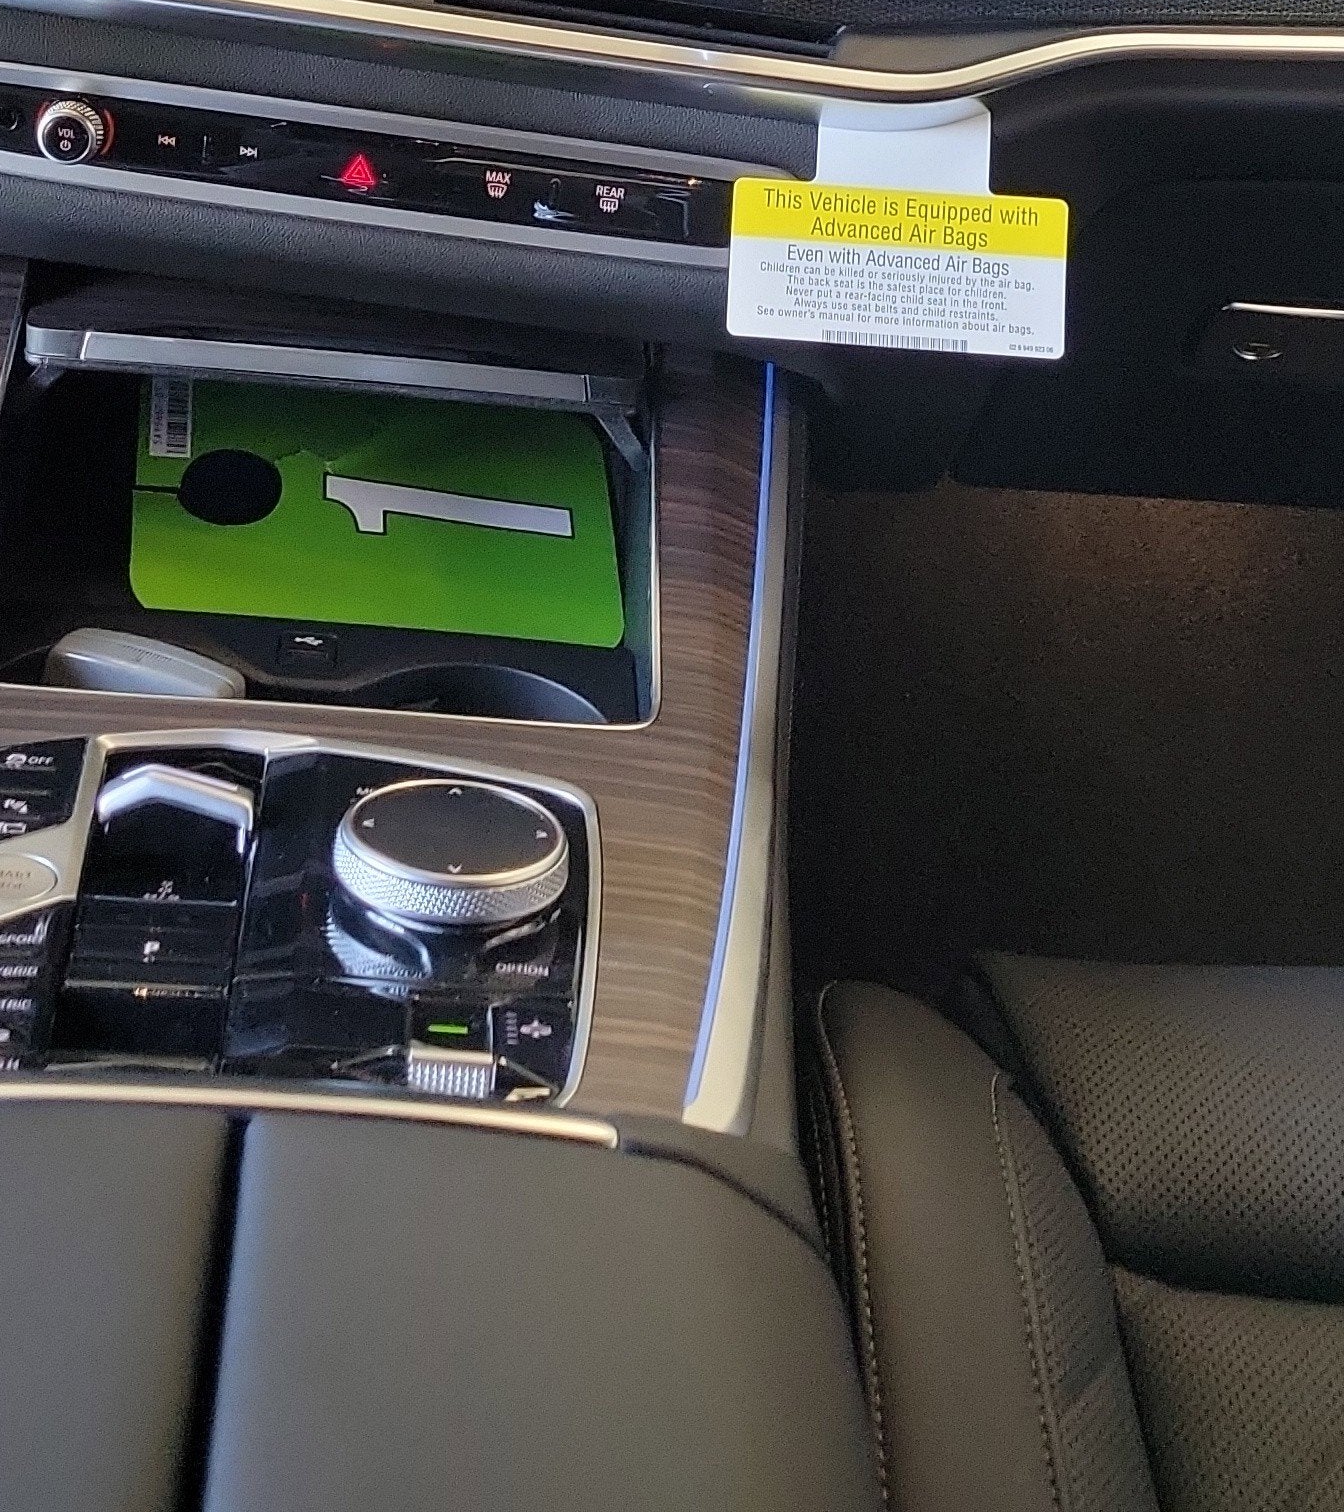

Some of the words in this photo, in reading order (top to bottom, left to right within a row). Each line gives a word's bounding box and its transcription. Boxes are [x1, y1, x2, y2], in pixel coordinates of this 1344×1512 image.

[58, 126, 76, 139] VOL
[485, 169, 511, 185] MAX
[595, 184, 625, 201] REAR
[763, 188, 802, 210] This
[810, 191, 877, 216] Vehicle
[883, 197, 899, 217] is
[906, 198, 992, 225] Equipped
[999, 205, 1038, 227] with
[810, 216, 902, 242] Advanced
[909, 224, 937, 245] Air
[944, 226, 989, 251] Bags
[787, 244, 824, 263] Even
[828, 247, 862, 266] with
[866, 250, 940, 272] Advanced
[945, 255, 968, 274] Air
[972, 257, 1010, 279] Bags
[760, 261, 801, 274] Children
[804, 266, 821, 275] can
[824, 266, 836, 276] be
[838, 267, 864, 278] killed
[867, 270, 878, 279] or
[881, 271, 925, 284] seriously
[928, 273, 962, 285] injured
[965, 276, 976, 287] by
[980, 277, 995, 288] the
[998, 279, 1011, 289] air
[1014, 279, 1035, 292] bag.
[788, 274, 805, 285] The
[808, 275, 830, 287] back
[834, 279, 854, 289] seat
[857, 279, 865, 289] is
[868, 280, 884, 291] the
[886, 282, 916, 294] safest
[919, 285, 944, 296] place
[948, 286, 961, 296] for
[964, 288, 1007, 300] children.
[786, 285, 814, 297] Never
[817, 289, 833, 299] put
[836, 290, 841, 299] a
[844, 290, 897, 304] rear-facing
[900, 294, 924, 305] child
[927, 296, 947, 306] seat
[950, 297, 959, 308] in
[962, 298, 978, 309] the
[981, 300, 1007, 311] front.
[794, 297, 828, 311] Always
[831, 301, 848, 310] use
[851, 302, 871, 313] seat
[875, 303, 898, 314] belts
[901, 305, 919, 316] and
[922, 307, 946, 318] child
[949, 309, 998, 321] restraints.
[757, 305, 775, 316] See
[778, 308, 815, 319] owner's
[818, 310, 854, 322] manual
[857, 313, 871, 323] for
[874, 315, 900, 325] more
[902, 316, 959, 329] information
[962, 321, 989, 332] about
[992, 323, 1005, 333] air
[1008, 323, 1034, 336] bags.
[325, 472, 575, 535] 1
[28, 755, 54, 765] OFF
[143, 940, 161, 955] P
[495, 961, 550, 977] OPTION
